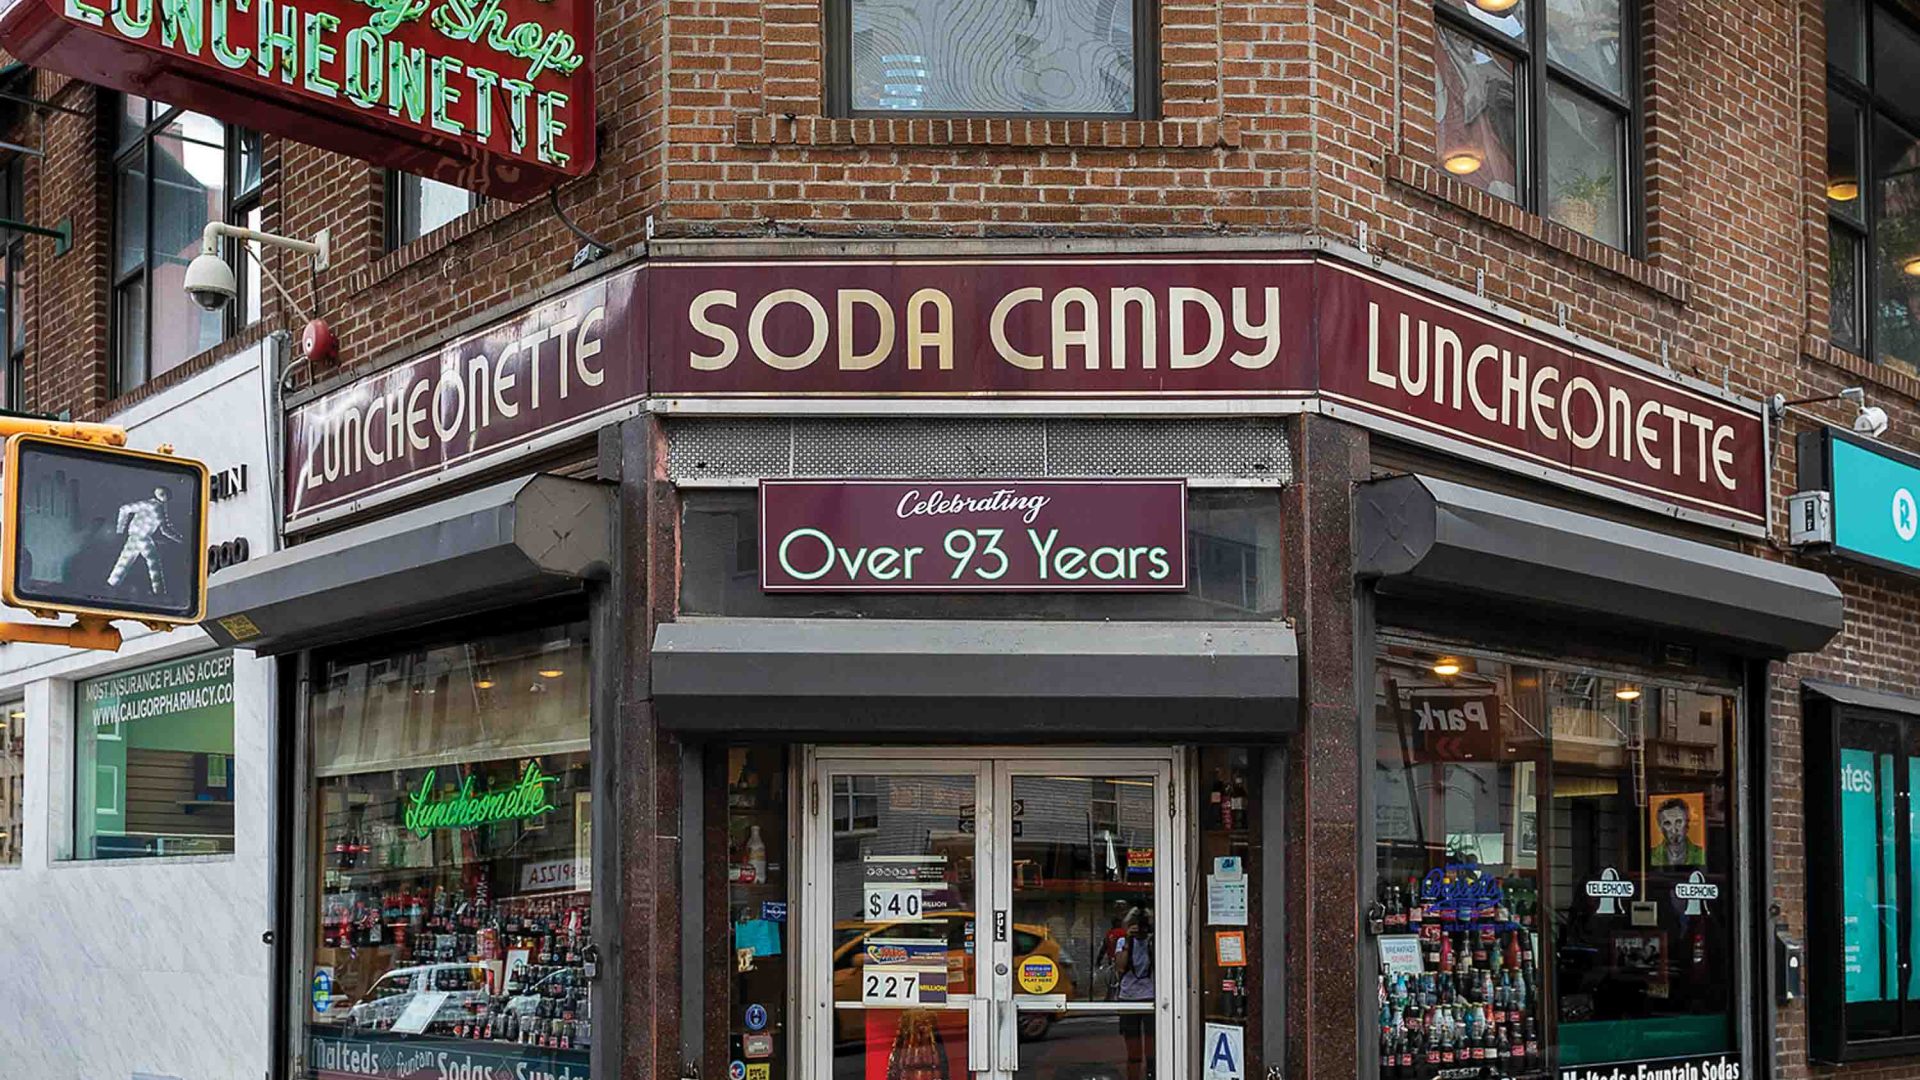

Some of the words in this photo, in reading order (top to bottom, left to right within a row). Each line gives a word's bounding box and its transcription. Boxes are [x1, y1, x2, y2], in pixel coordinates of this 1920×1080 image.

[65, 0, 570, 168] NCHEONETTE
[688, 288, 955, 371] SODA
[989, 286, 1281, 370] CANDY
[307, 306, 605, 490] LUNCHEONETTE
[1367, 301, 1736, 491] LUNCHEONETTE
[896, 489, 1051, 523] Celebrating
[778, 527, 923, 581] Over
[943, 528, 1009, 581] 93
[1026, 527, 1170, 581] Years
[86, 682, 109, 702] MOST
[110, 671, 162, 697] INSURANCE
[163, 664, 195, 688] PLANS
[196, 656, 235, 681] ACCEP
[93, 682, 235, 726] WWW.CALIGORPHARMACY.CO
[406, 761, 561, 841] Luncheonette
[1588, 883, 1632, 896] TELEPHONE
[1677, 885, 1716, 897] TELEPHONE
[866, 975, 916, 998] 227
[311, 1038, 379, 1075] Malteds
[437, 1051, 494, 1080] Sodas
[1210, 1032, 1237, 1072] A
[1702, 1056, 1740, 1080] Sodas
